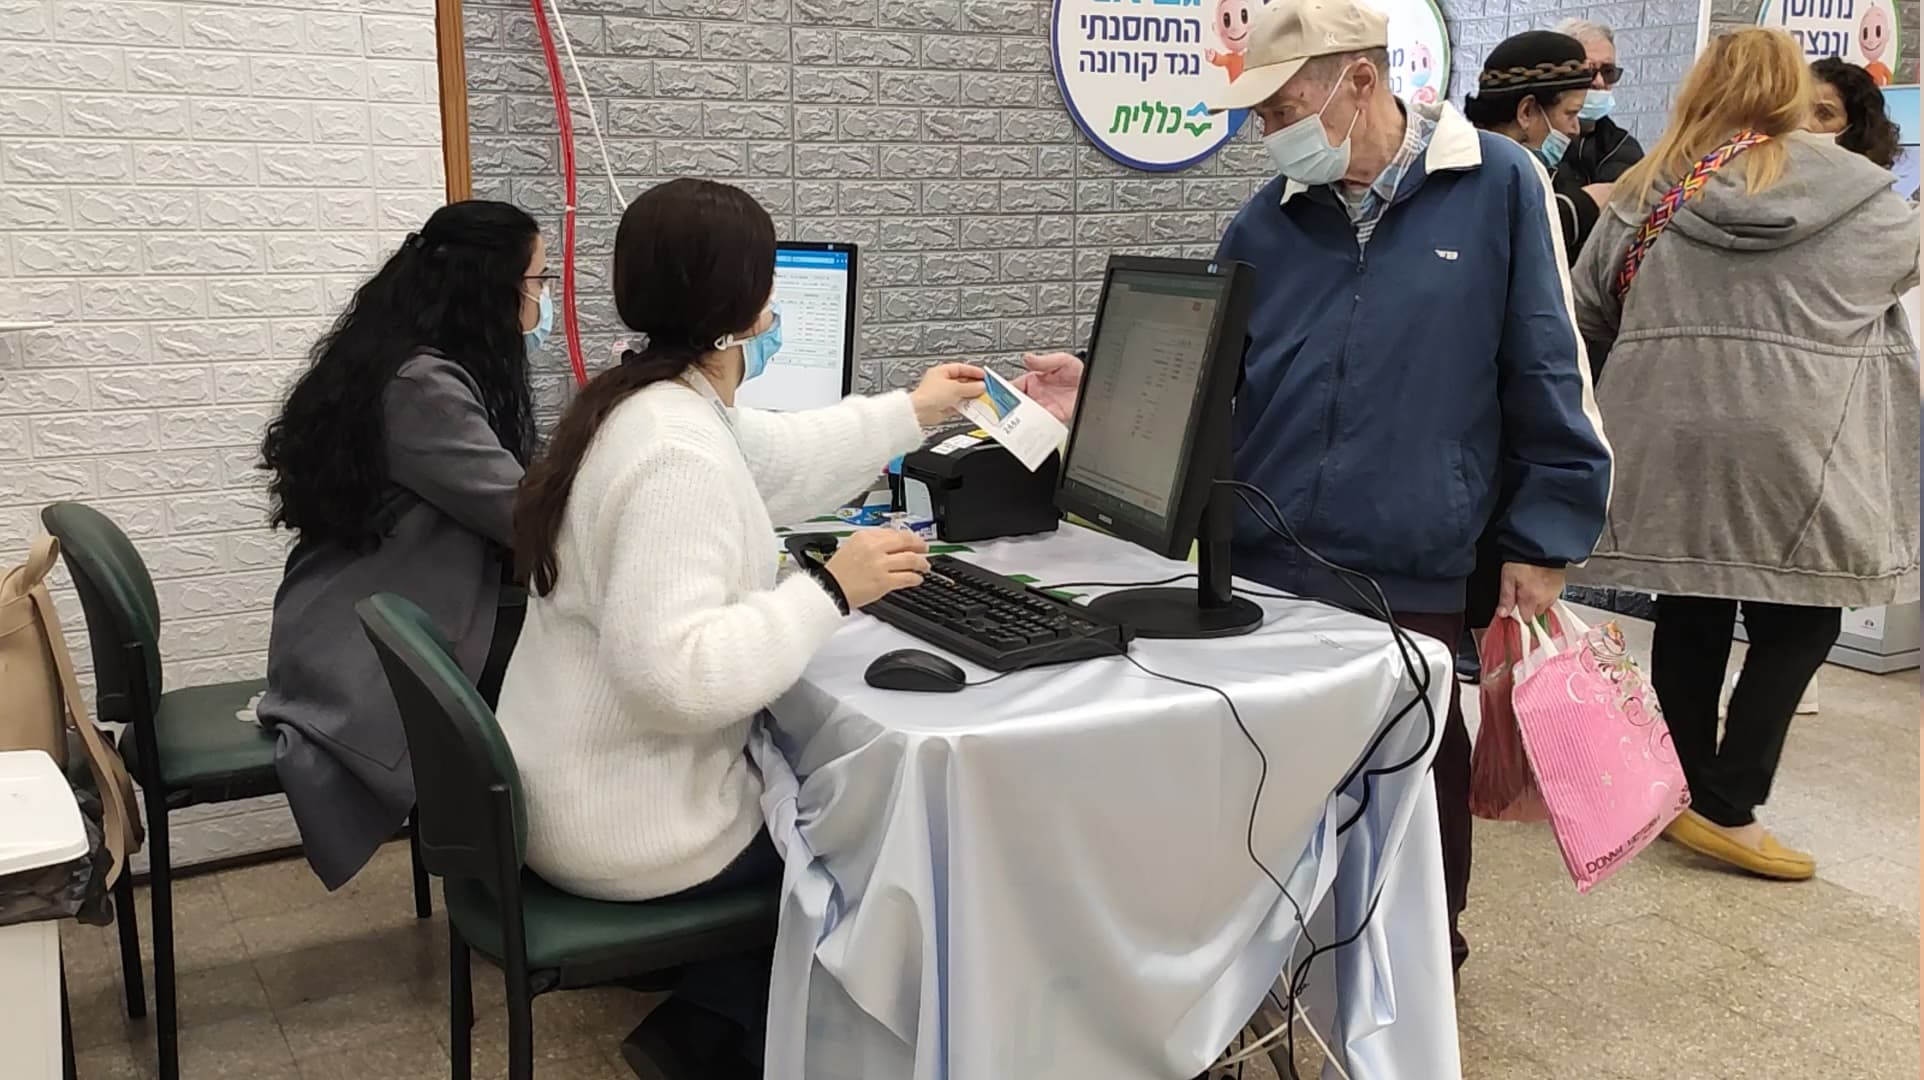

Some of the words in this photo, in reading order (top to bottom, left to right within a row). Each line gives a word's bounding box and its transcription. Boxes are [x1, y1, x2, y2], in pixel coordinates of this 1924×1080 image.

[1080, 15, 1200, 43] התחסנתי
[1080, 50, 1157, 82] קורונה
[1164, 52, 1200, 75] נגד
[1109, 101, 1182, 134] כללית
